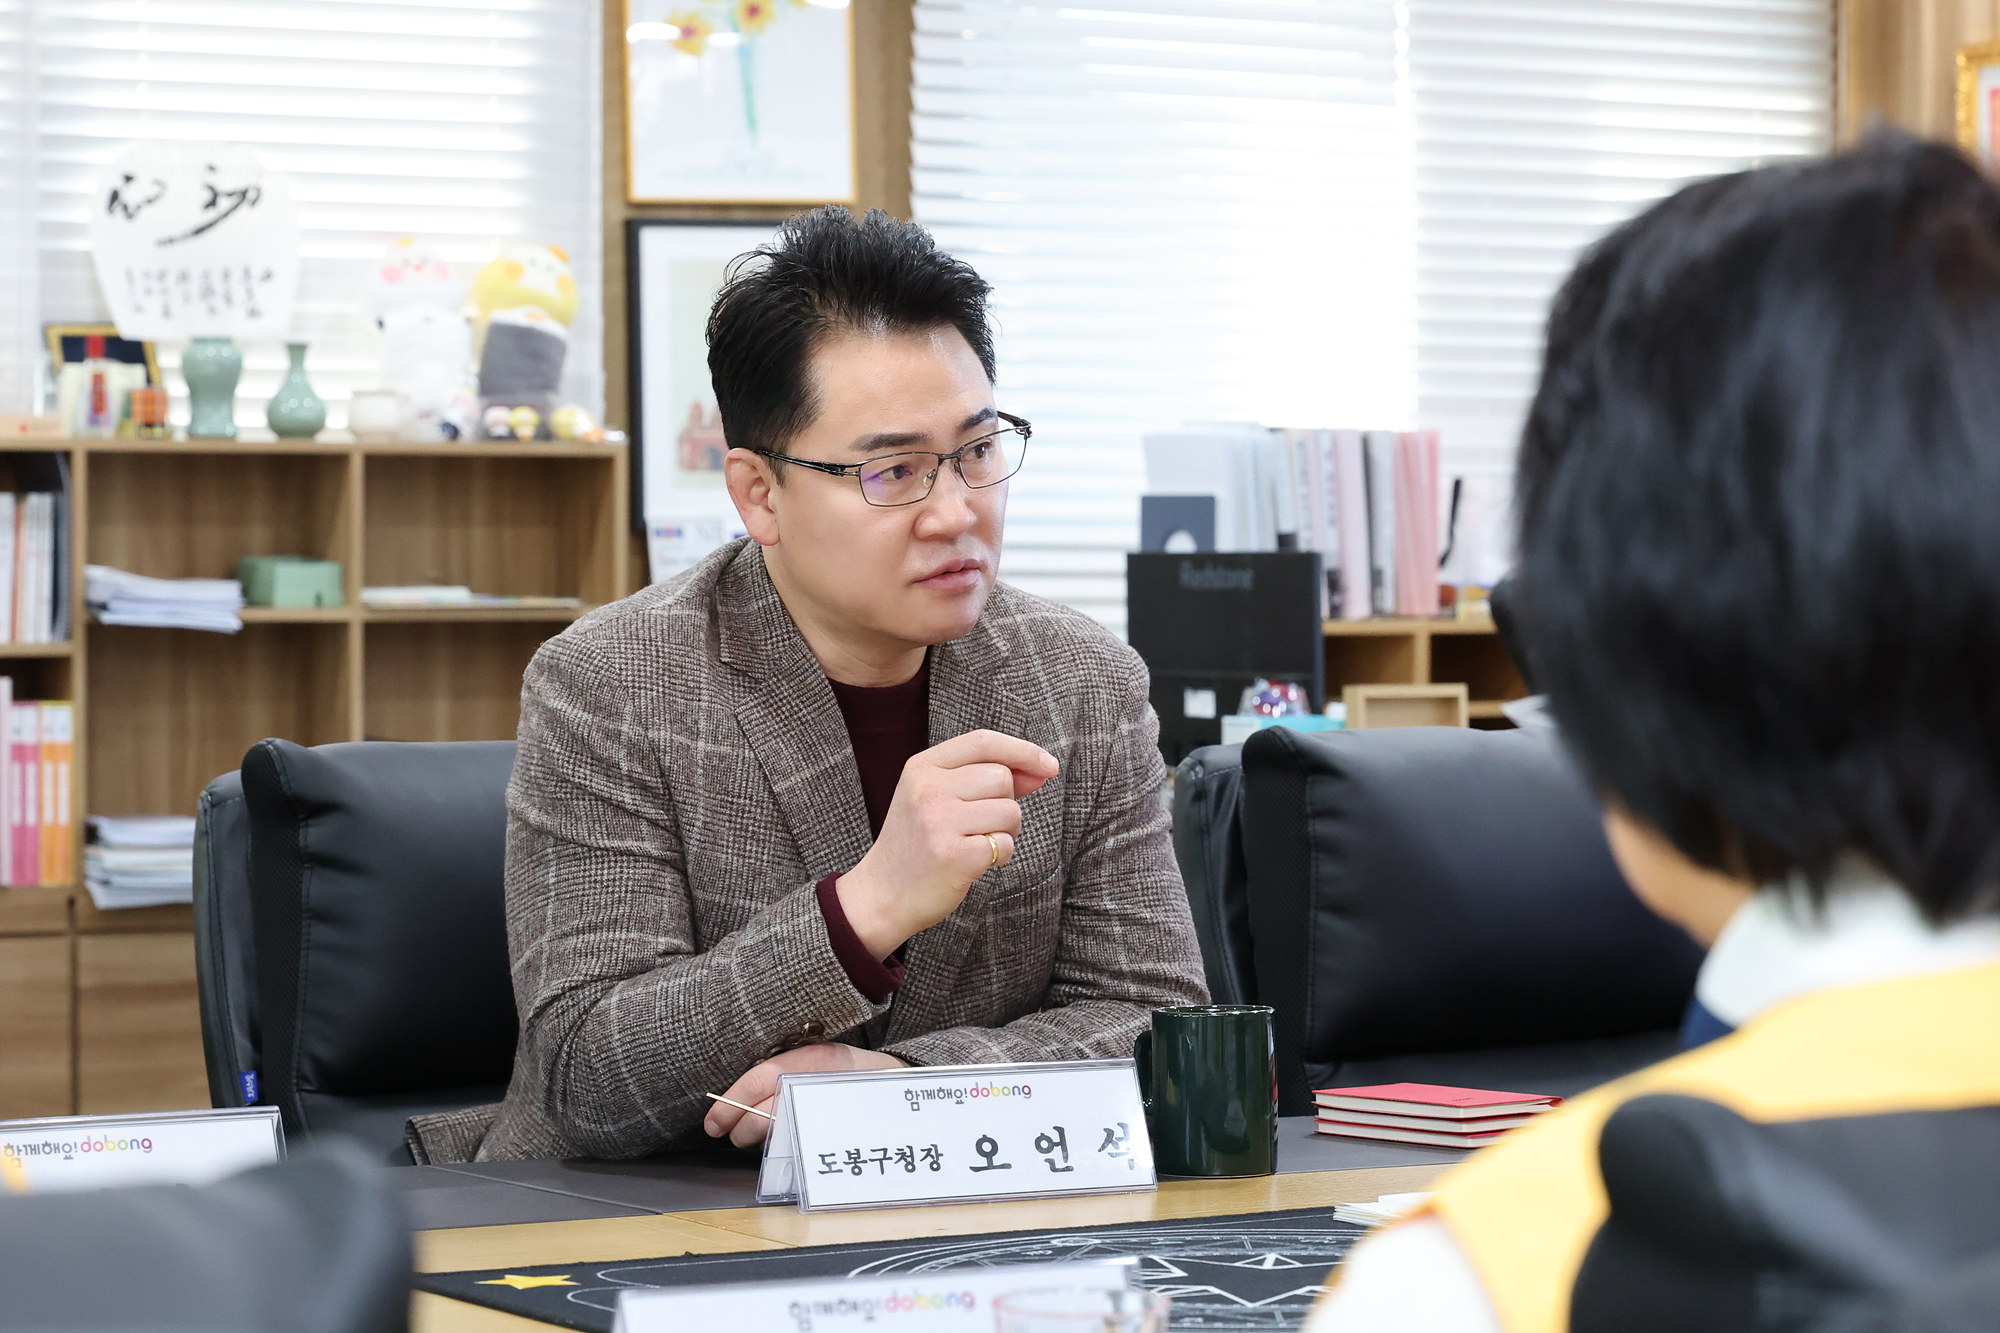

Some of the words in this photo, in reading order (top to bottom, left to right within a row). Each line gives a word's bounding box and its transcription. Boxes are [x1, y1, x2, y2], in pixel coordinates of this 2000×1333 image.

[818, 1144, 943, 1176] 도봉구청장
[969, 1134, 1012, 1172] 오
[1034, 1126, 1074, 1173] 언
